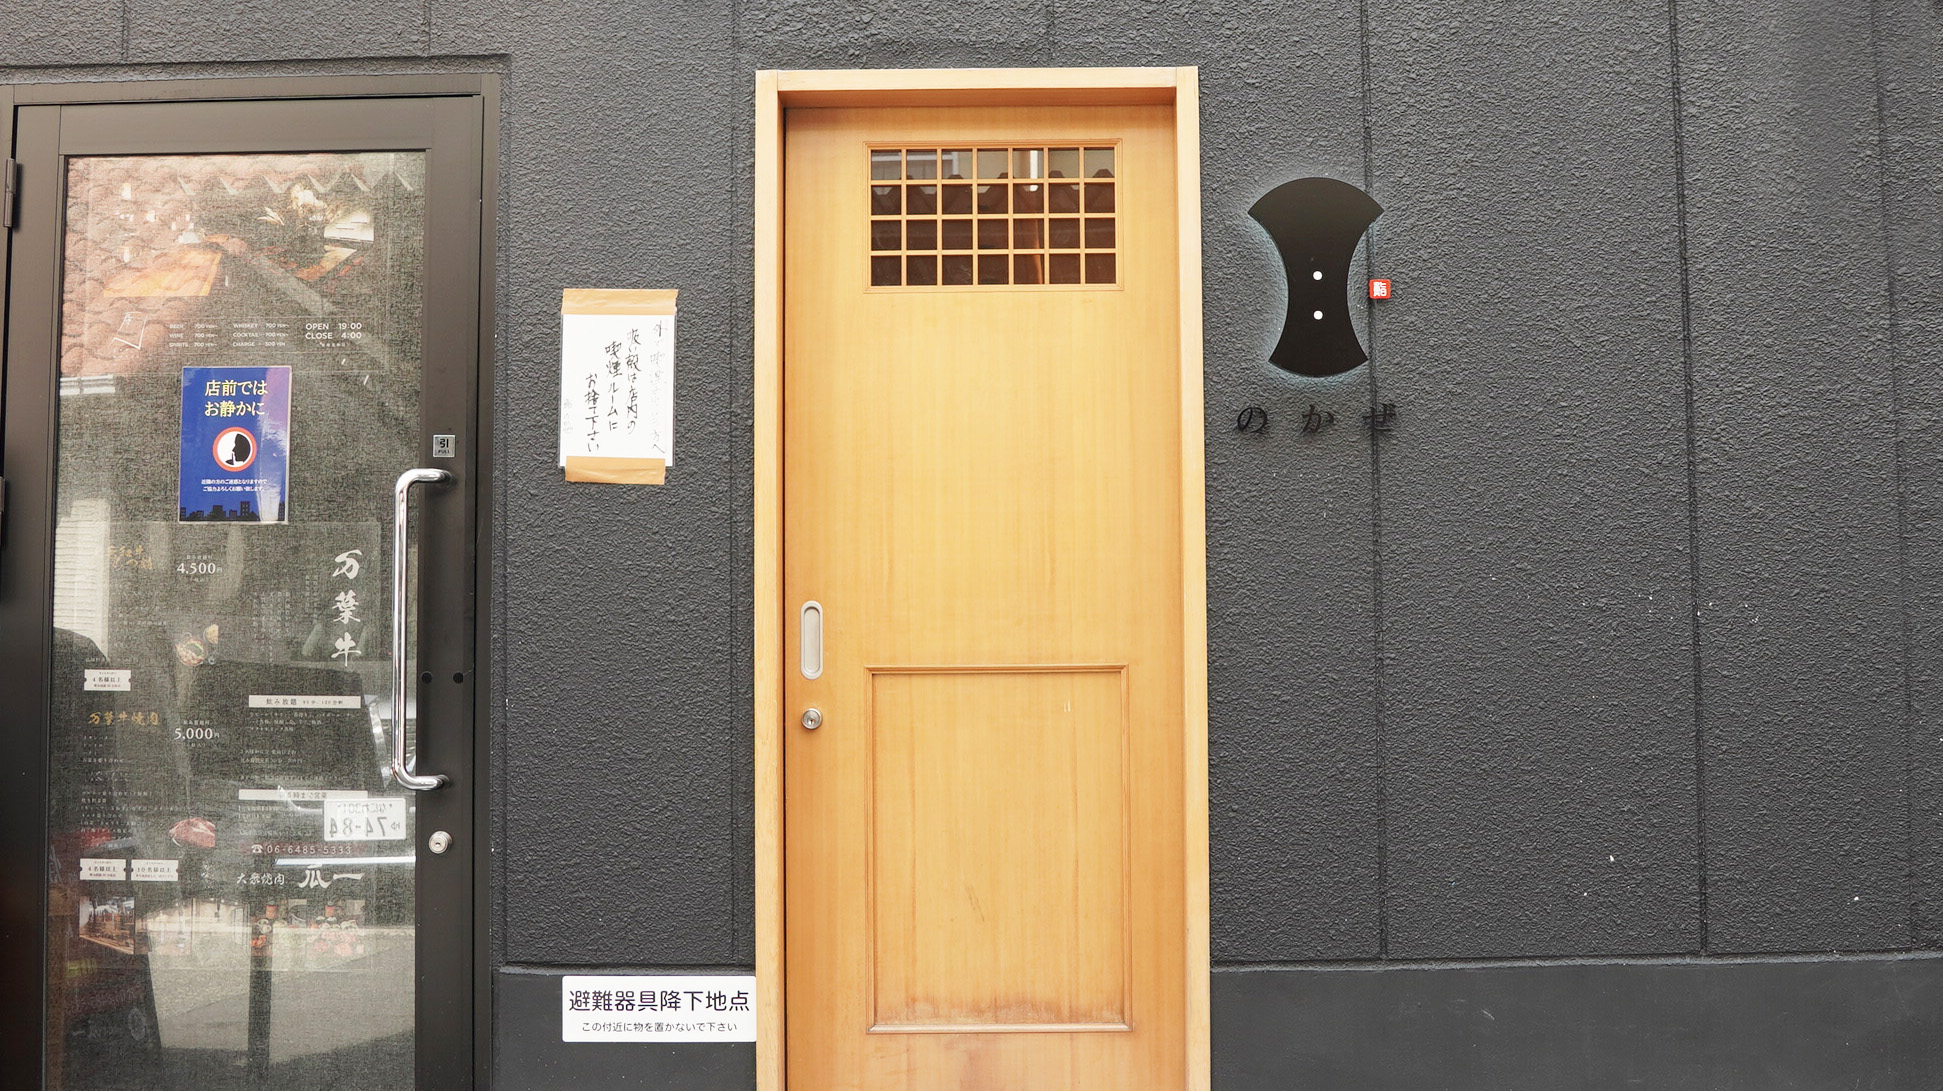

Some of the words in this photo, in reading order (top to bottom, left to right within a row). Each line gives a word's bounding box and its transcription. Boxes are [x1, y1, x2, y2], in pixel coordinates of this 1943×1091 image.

[338, 322, 362, 330] 19:00
[204, 379, 269, 397] 店前では
[604, 340, 622, 432] 喫煙ルームに
[204, 400, 266, 418] お静かに
[584, 372, 600, 453] お捨て下さい
[439, 438, 449, 448] 引
[331, 549, 363, 667] 万葉牛
[266, 698, 297, 706] 飲み放題
[266, 845, 351, 855] 06-6485-5333
[568, 989, 750, 1012] 避難器具降下地点
[582, 1022, 738, 1033] この付近に物を置かないで下さい
